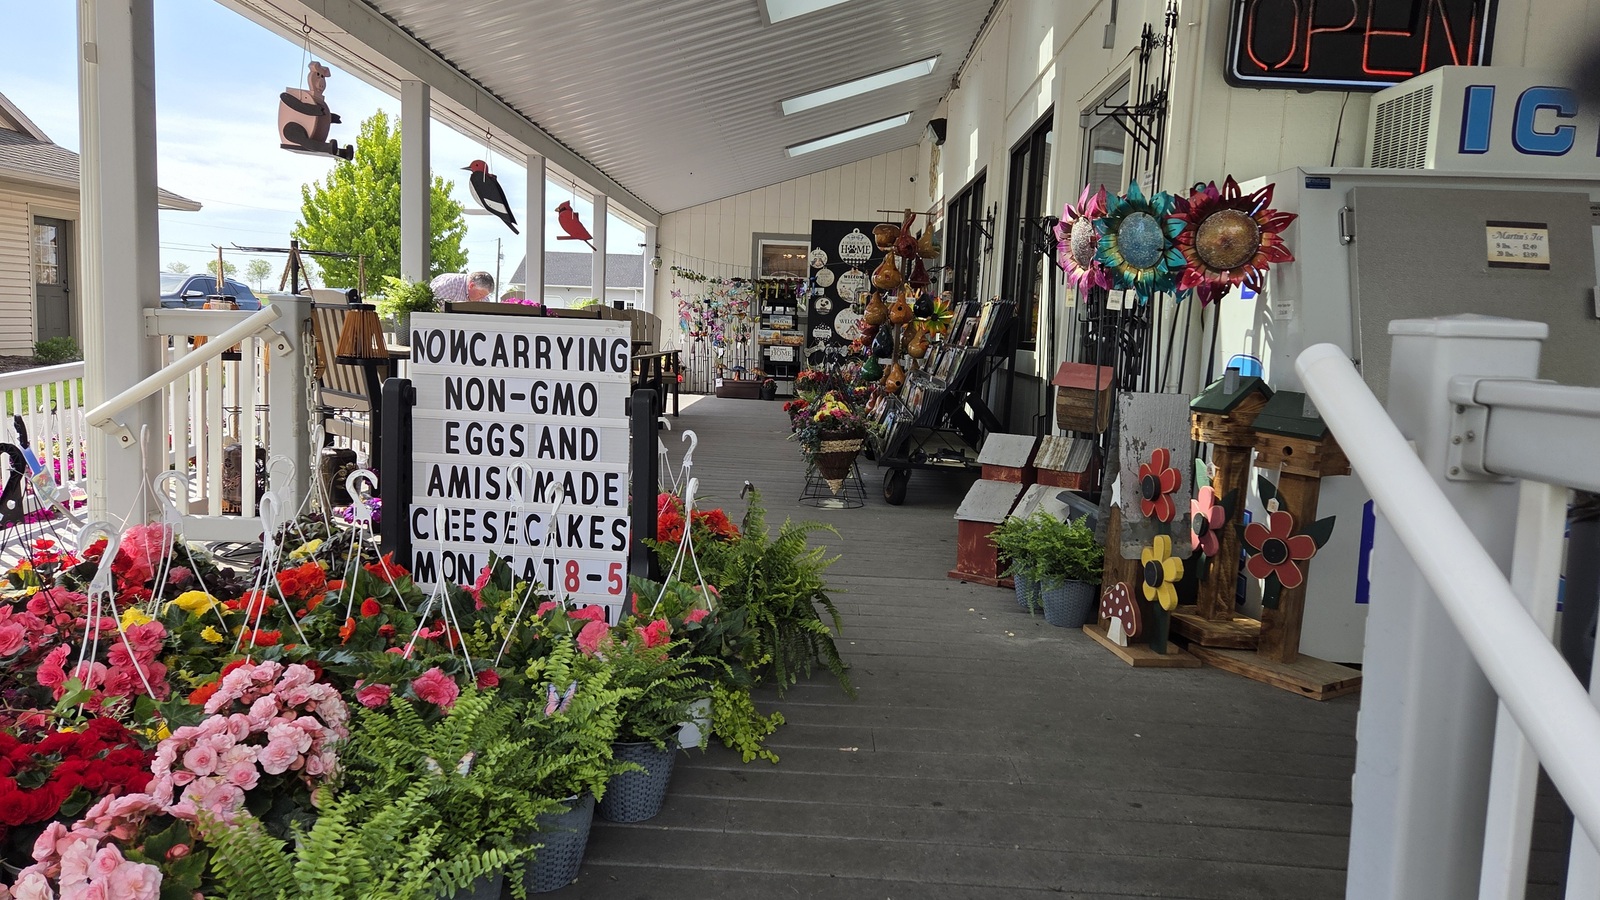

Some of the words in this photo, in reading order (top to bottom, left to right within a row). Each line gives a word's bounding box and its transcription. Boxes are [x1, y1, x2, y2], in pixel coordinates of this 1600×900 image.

[1247, 0, 1478, 76] OPEN
[1458, 84, 1600, 157] IC
[1492, 231, 1529, 241] Martin's
[1529, 232, 1544, 241] Ice
[445, 376, 598, 417] NON-GMO
[445, 421, 525, 458] EGGS
[537, 425, 599, 462] AND
[533, 470, 619, 507] MADE
[413, 550, 475, 586] MON
